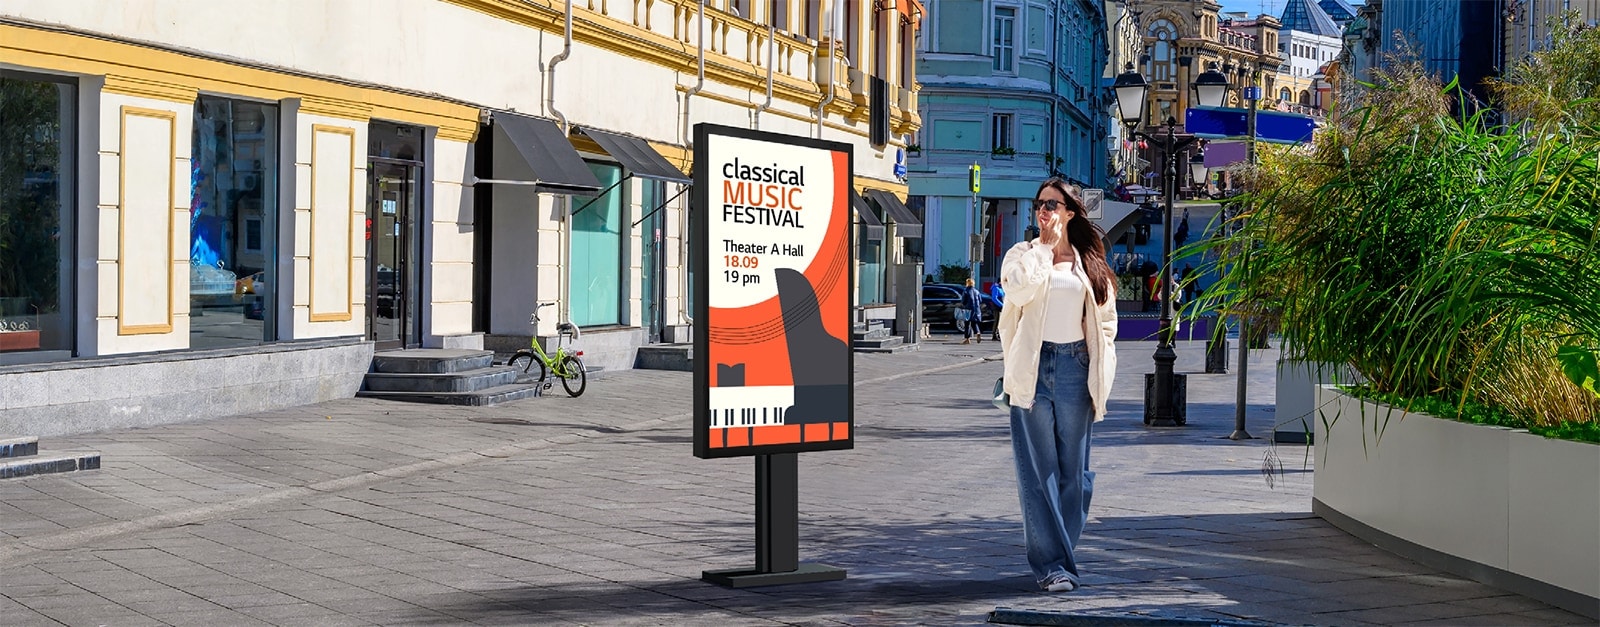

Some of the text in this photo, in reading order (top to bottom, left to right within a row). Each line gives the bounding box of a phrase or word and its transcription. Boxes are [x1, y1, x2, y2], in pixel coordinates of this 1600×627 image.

[723, 157, 804, 186] classical
[723, 180, 802, 210] MUSIC
[723, 204, 804, 228] FESTIVAL
[723, 239, 804, 256] Theater A Hall
[724, 255, 759, 268] 18.09
[724, 270, 760, 286] 19 pm
